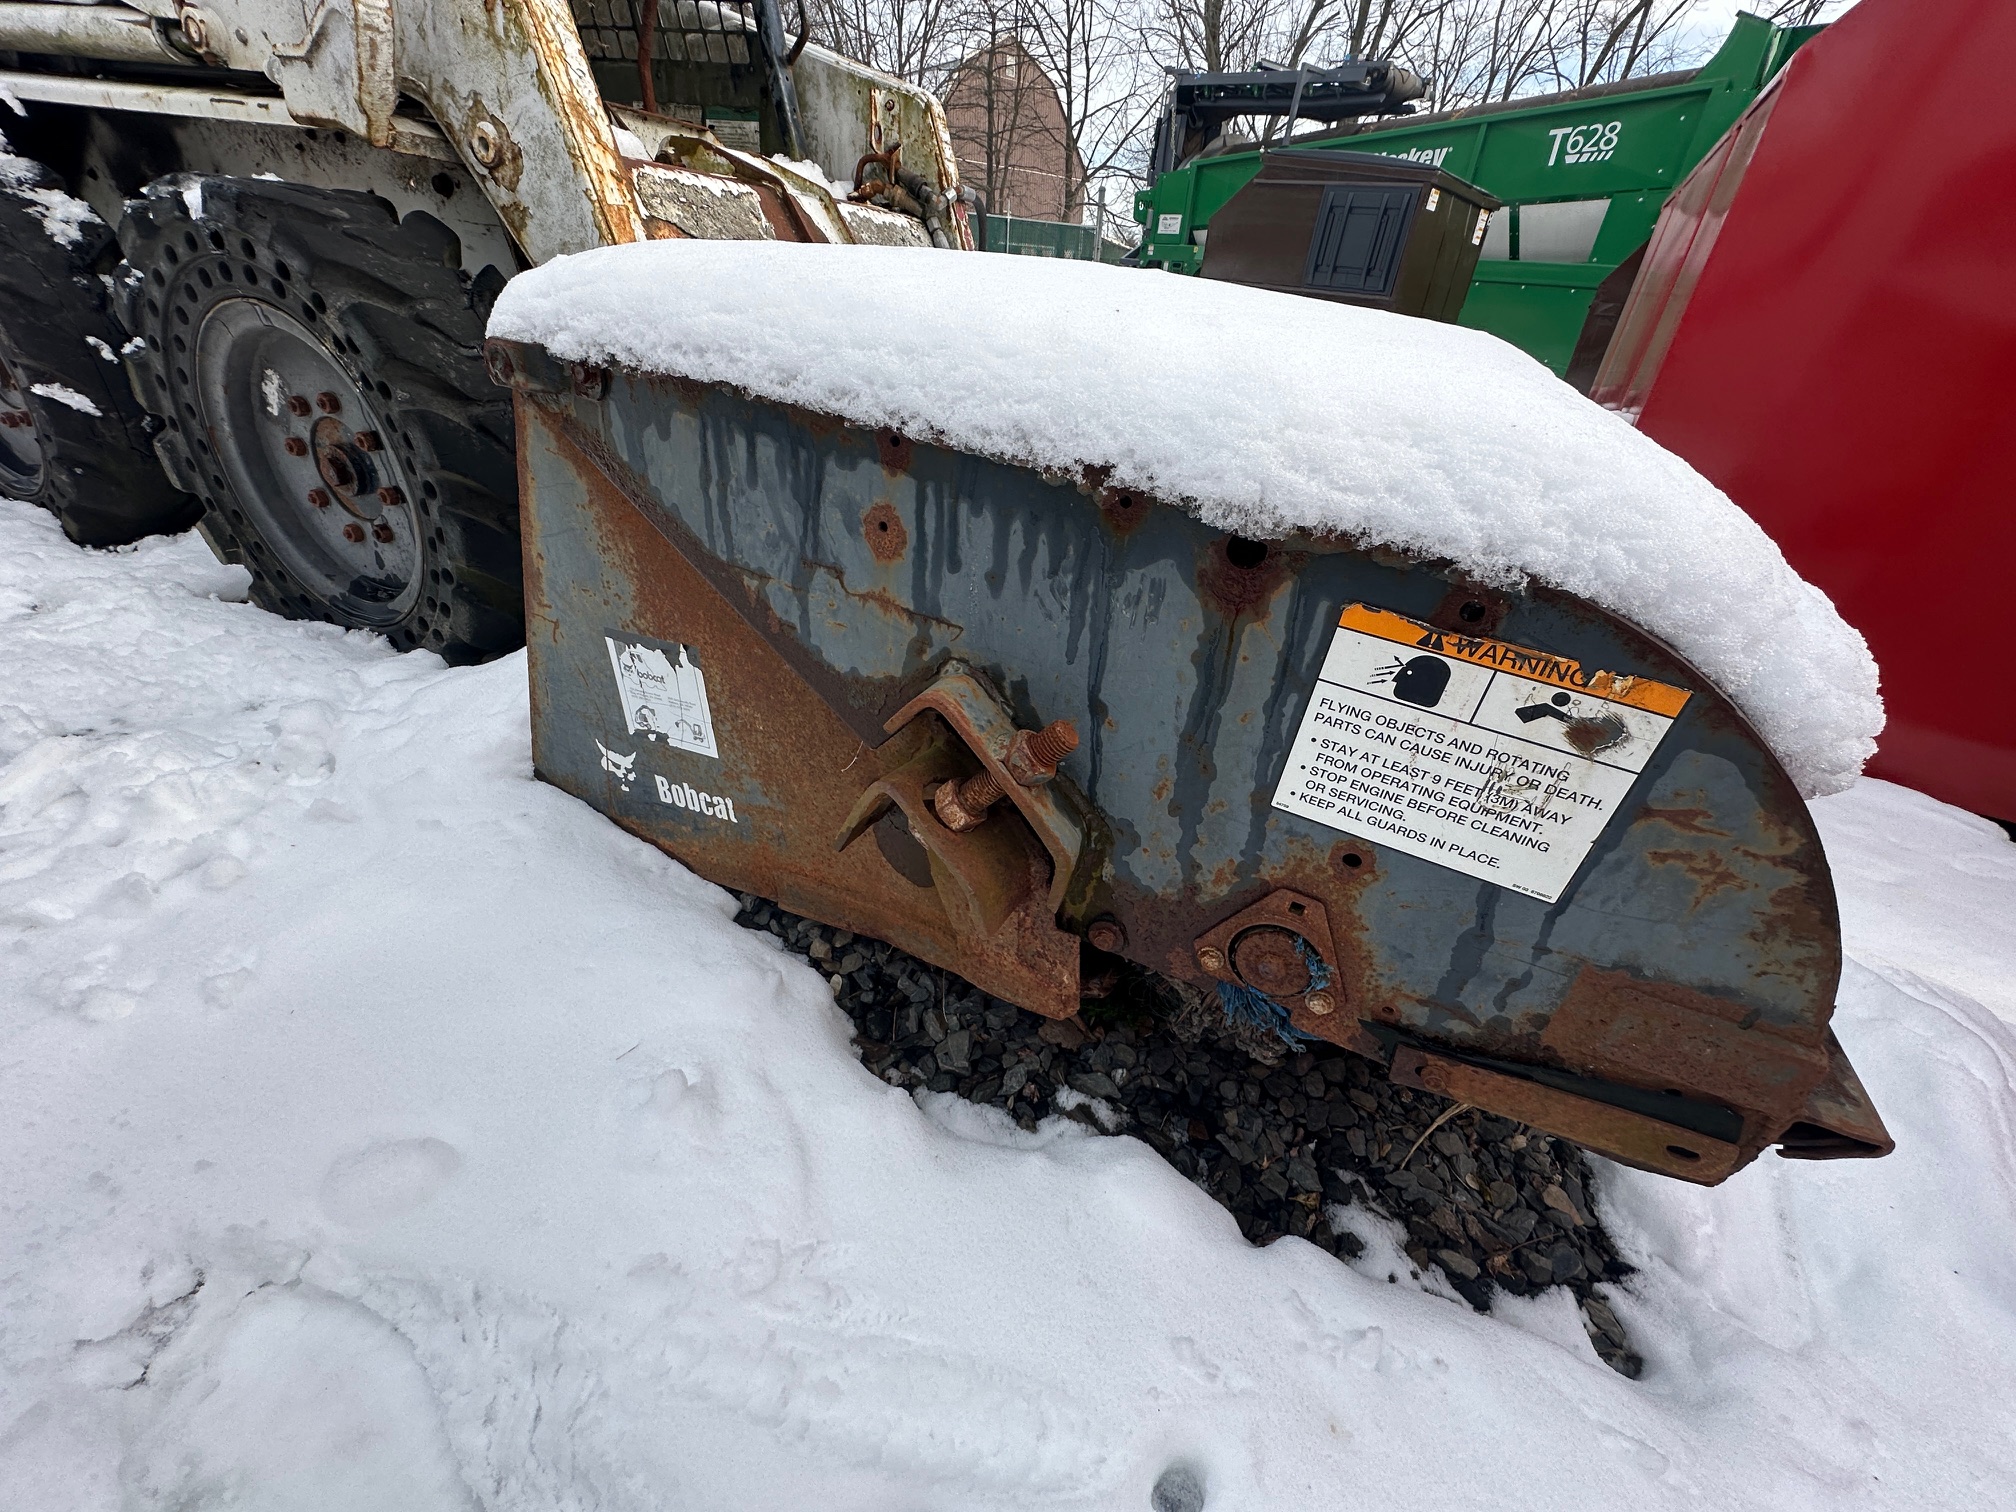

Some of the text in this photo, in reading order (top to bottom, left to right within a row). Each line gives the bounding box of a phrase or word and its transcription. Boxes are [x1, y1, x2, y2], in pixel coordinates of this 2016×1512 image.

[1548, 121, 1622, 166] T628
[1313, 712, 1603, 811] PARTS CAN CAUSE INJURY OR DEATH.
[1319, 697, 1571, 782] FLYING OBJECTS AND ROTATING
[654, 774, 738, 823] Bobcat
[1305, 779, 1406, 821] OR SERVICING.
[1309, 766, 1551, 853] STOP ENGINE BEFORE CLEANING
[1315, 752, 1544, 835] FROM OPERATING EQUIPMENT.
[1320, 738, 1573, 825] STAY AT LEAST 9 FEET (3M) AWAY
[1299, 792, 1500, 869] KEEP ALL GUARDS IN PLACE.
